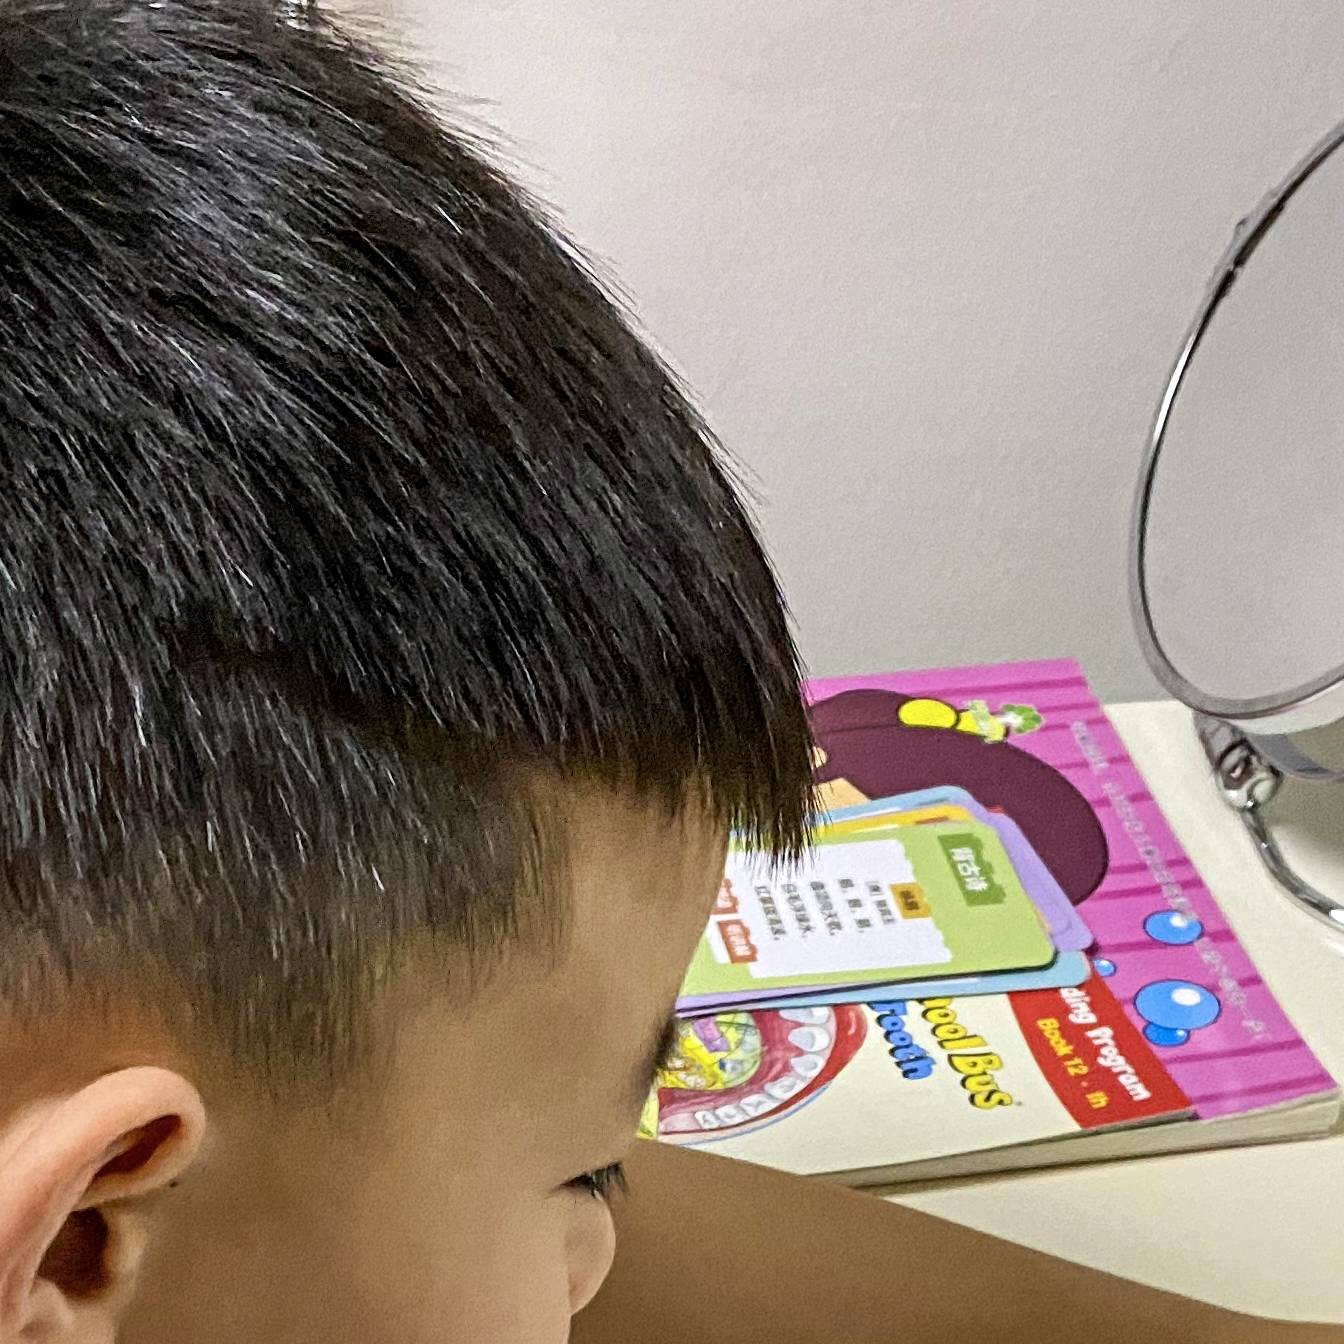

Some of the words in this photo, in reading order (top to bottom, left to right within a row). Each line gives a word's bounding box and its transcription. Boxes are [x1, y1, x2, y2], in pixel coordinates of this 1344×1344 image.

[1036, 1018, 1074, 1058] Book
[1064, 1058, 1088, 1077] 12
[1060, 987, 1097, 1024] ding
[1085, 1027, 1151, 1101] Program
[948, 1052, 1012, 1110] Bus
